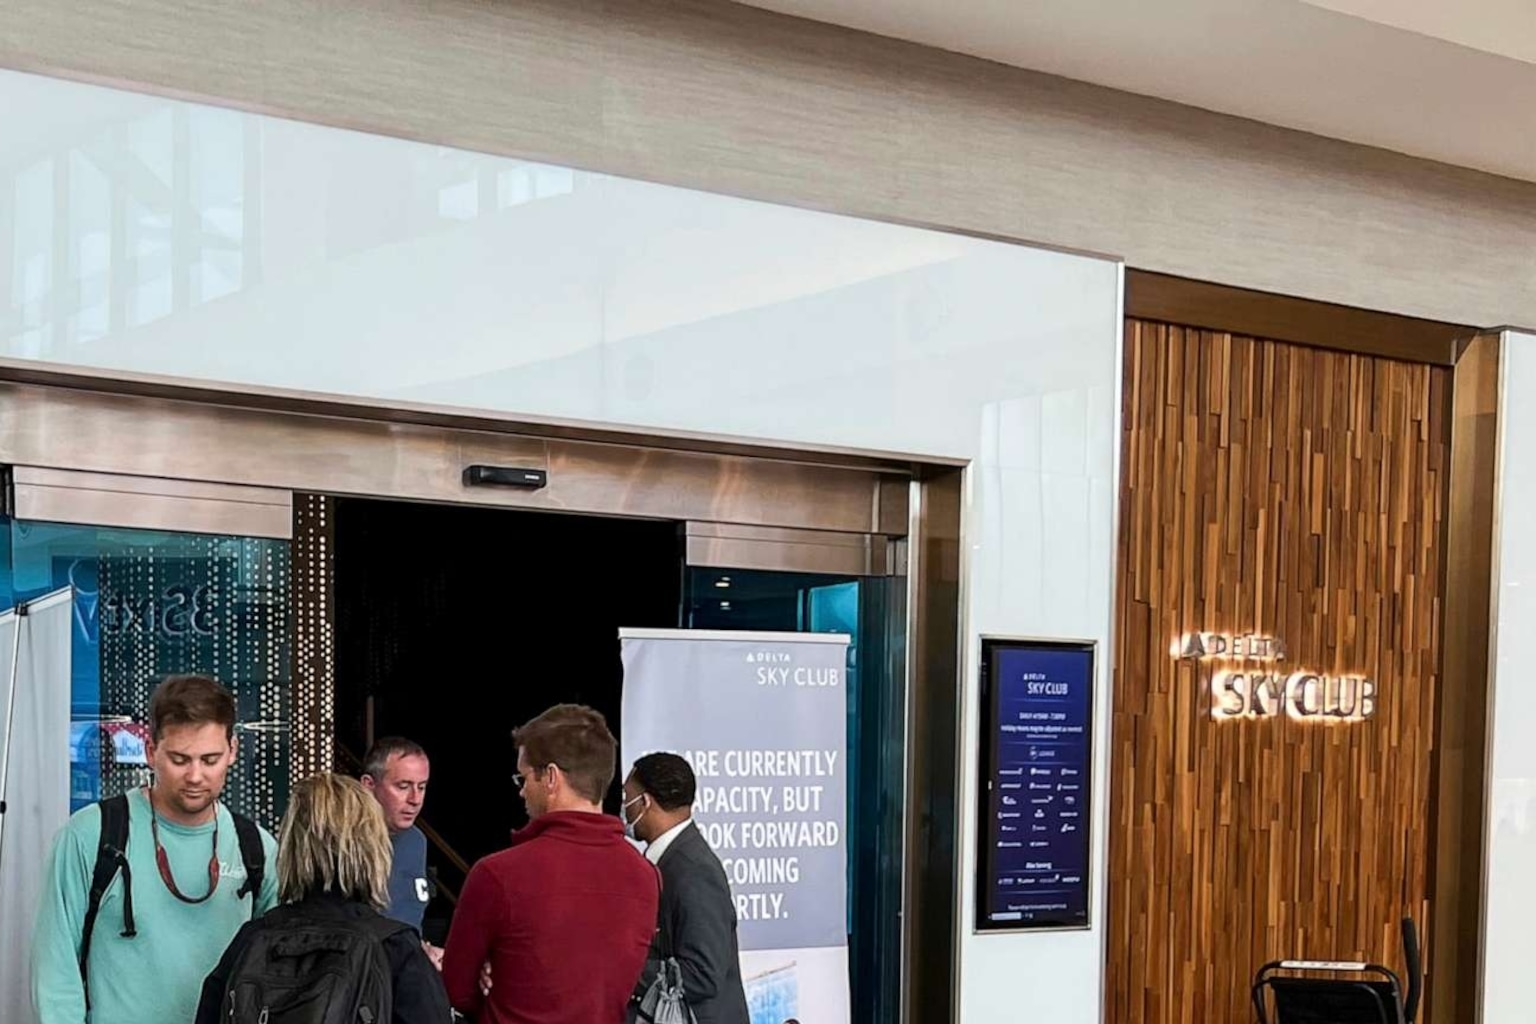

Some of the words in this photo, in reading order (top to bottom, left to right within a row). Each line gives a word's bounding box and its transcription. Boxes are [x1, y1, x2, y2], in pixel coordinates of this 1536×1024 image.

[757, 652, 791, 663] DELTA
[1207, 634, 1286, 660] DELTA
[757, 666, 790, 687] SKY
[794, 667, 839, 687] CLUB
[1027, 682, 1045, 695] SKY
[1045, 682, 1068, 695] CLUB
[1222, 673, 1288, 717] SKY
[1291, 673, 1378, 718] CLUB
[724, 750, 838, 778] CURRENTLY
[691, 786, 778, 816] APACITY,
[783, 786, 823, 813] BUT
[741, 821, 839, 849] FORWARD
[723, 857, 799, 885] COMING
[736, 892, 789, 921] RTLY.
